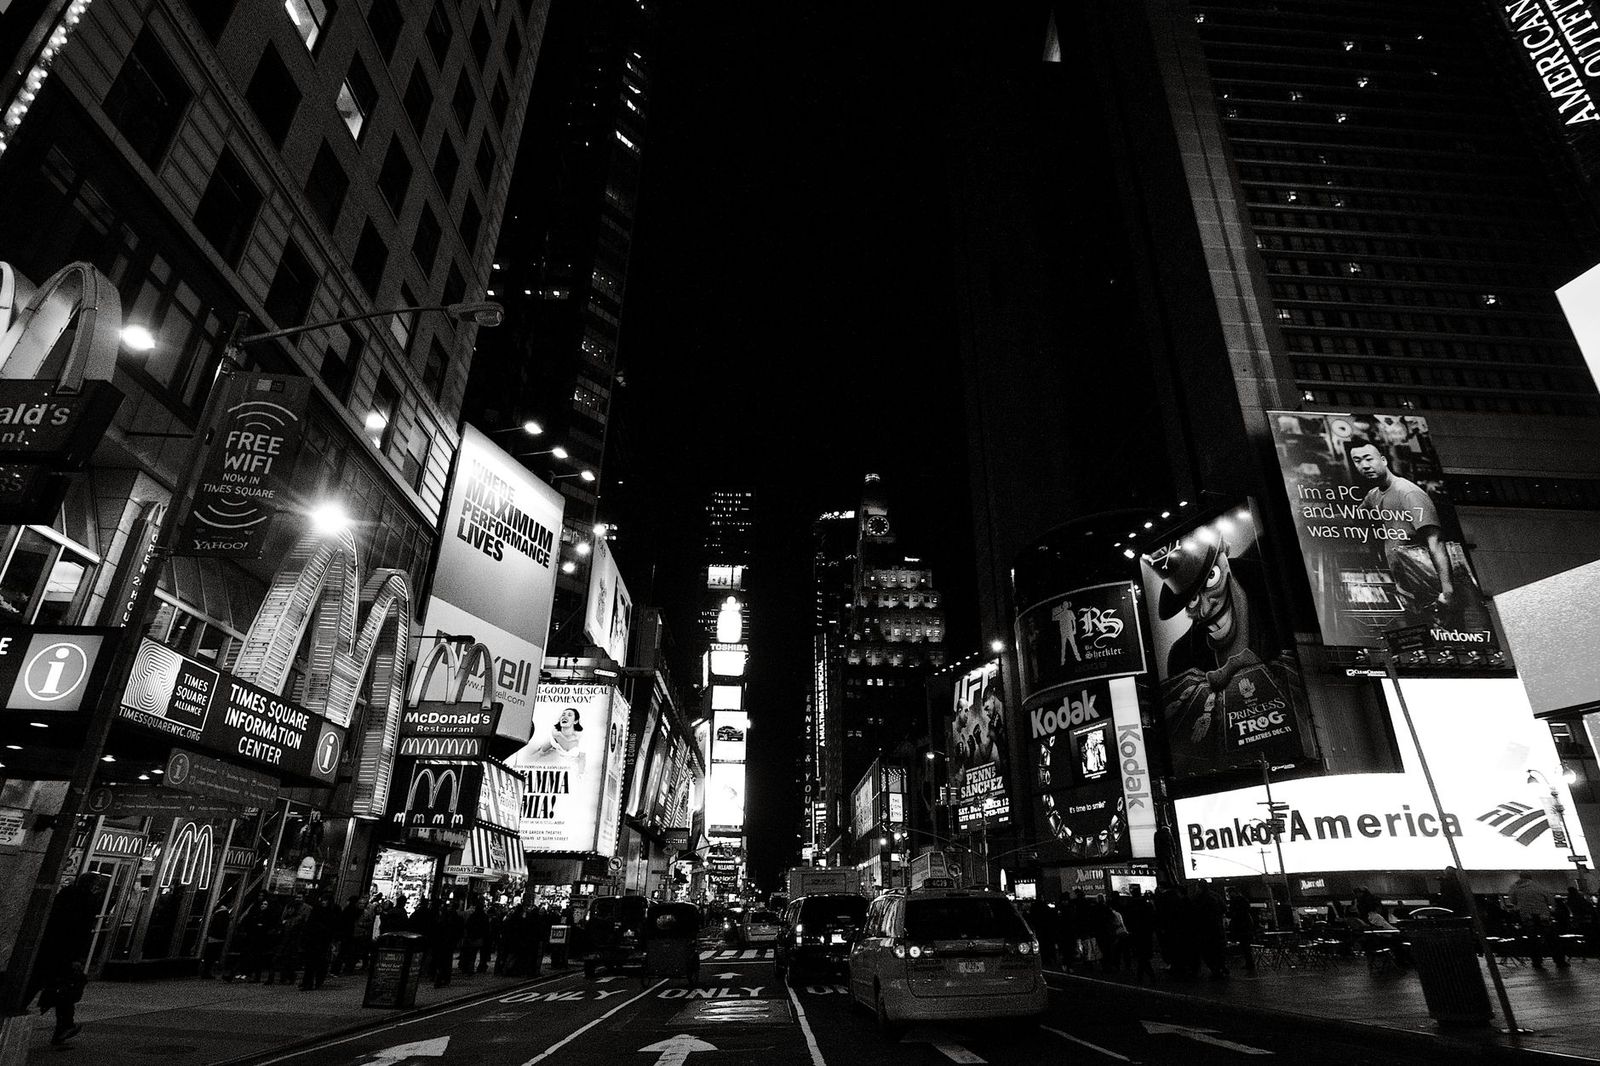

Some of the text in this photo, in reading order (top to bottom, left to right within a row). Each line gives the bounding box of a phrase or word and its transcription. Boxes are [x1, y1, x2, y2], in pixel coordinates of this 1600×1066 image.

[1505, 0, 1600, 125] AMERICAN
[225, 431, 284, 455] FREE
[223, 451, 273, 475] WIFI
[222, 473, 260, 485] NOW IN
[472, 459, 516, 502] WHERE
[203, 483, 276, 499] TIMES SQUARE
[1297, 484, 1363, 501] I'm a PC
[465, 477, 554, 554] MAXIMUM
[1303, 503, 1424, 523] and Windows 7
[457, 516, 505, 562] LIVES
[461, 498, 550, 569] PERFORMANCE
[1307, 523, 1411, 543] was my idea.
[193, 539, 248, 551] YAHOO!
[132, 576, 142, 587] 2
[711, 643, 748, 651] TOSHIBA
[1482, 630, 1491, 643] 7
[184, 673, 208, 692] TIMES
[573, 687, 608, 695] MUSICAL
[175, 685, 208, 706] SQUARE
[174, 699, 202, 716] ALLIANCE
[230, 683, 310, 731] TIMES SQUARE
[404, 711, 491, 725] McDonald's
[818, 691, 826, 740] MULTIMEDIA
[1030, 689, 1100, 739] Kodak
[1227, 697, 1286, 729] PRINCESS
[118, 706, 201, 742] TIMESSQUARENYC.ORG
[224, 707, 303, 750] INFORMATION
[416, 725, 474, 734] Restaurant
[1234, 711, 1287, 736] FROG
[238, 736, 282, 765] CENTER
[628, 733, 637, 756] COMING
[966, 767, 991, 785] PENN
[1117, 724, 1149, 809] Kodak
[520, 770, 569, 794] AMMA
[961, 776, 1004, 798] SANCHEZ
[1002, 798, 1009, 806] 12
[1187, 818, 1252, 852] Bank
[1290, 804, 1463, 843] America
[499, 989, 629, 1003] ONLY
[657, 986, 766, 1000] ONLY
